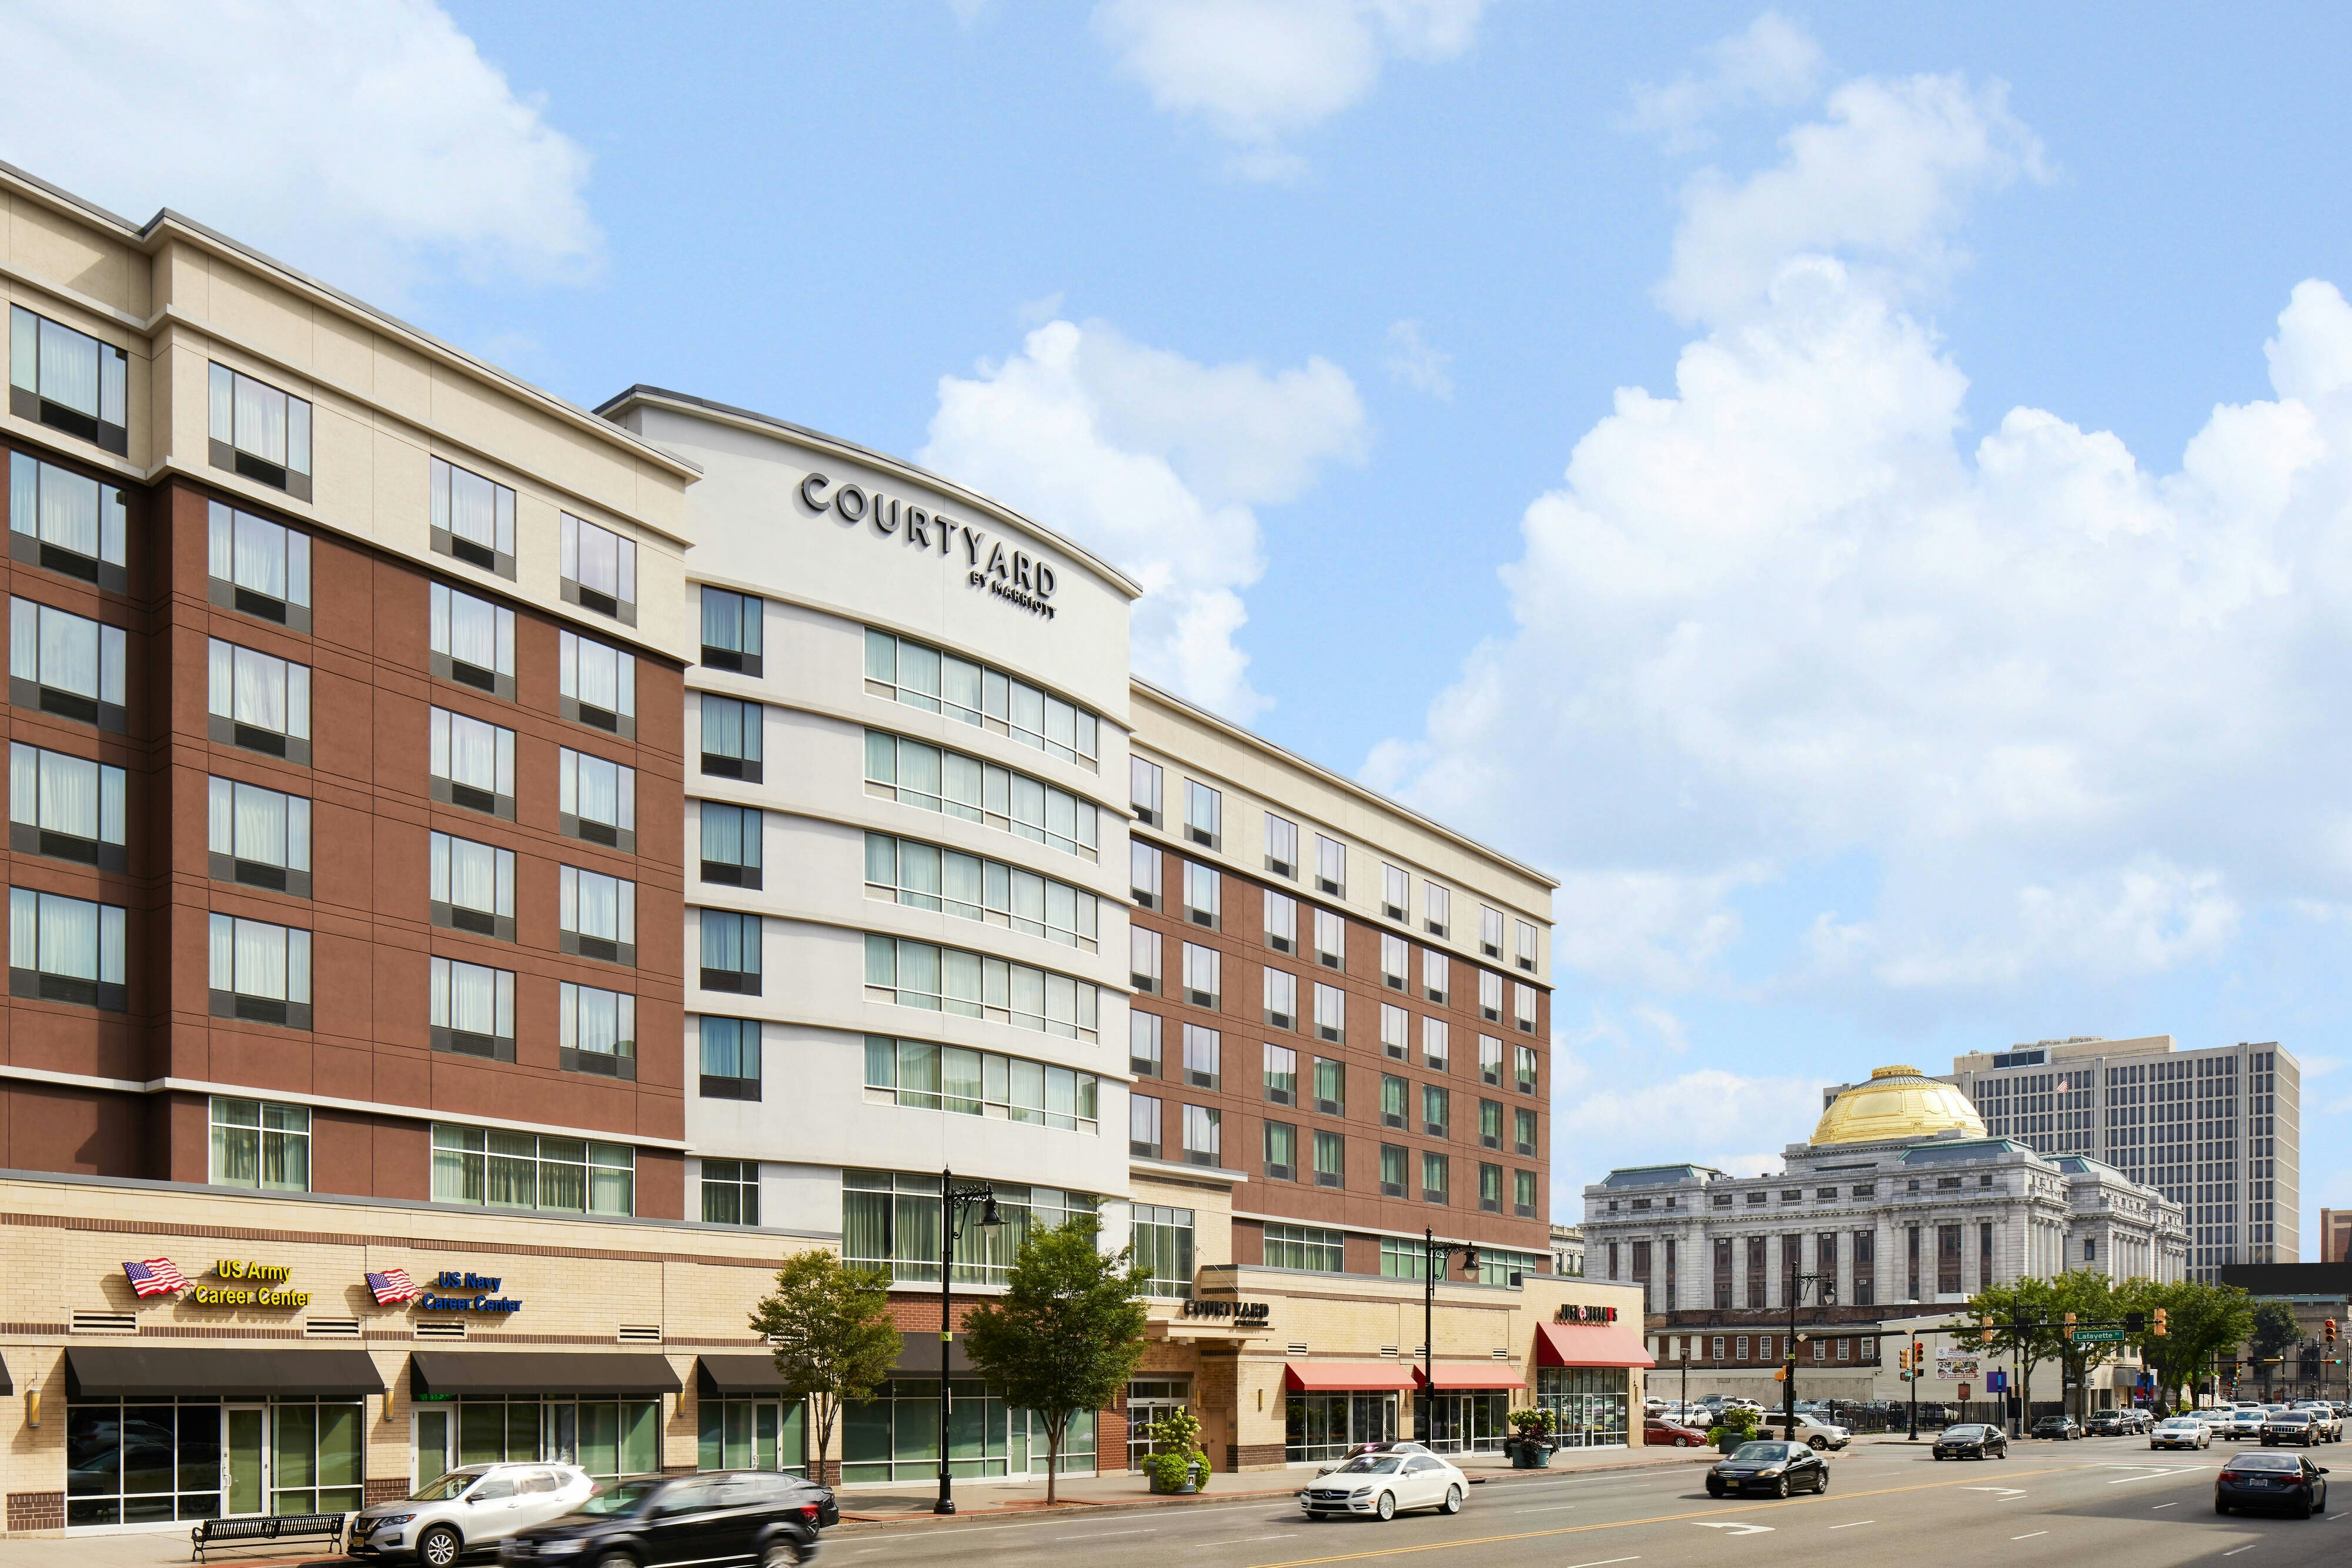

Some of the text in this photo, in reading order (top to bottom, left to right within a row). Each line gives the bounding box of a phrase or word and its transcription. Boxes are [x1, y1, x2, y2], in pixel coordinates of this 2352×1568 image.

[801, 472, 1057, 598] COURTYARD
[970, 571, 1057, 620] BY MARRIOTT
[217, 1260, 292, 1284] US Army
[439, 1271, 502, 1293] US Navy
[195, 1285, 313, 1306] Career Center
[422, 1293, 522, 1312] Career Center
[1184, 1299, 1269, 1318] COURTYARD
[1561, 1304, 1579, 1320] JUST
